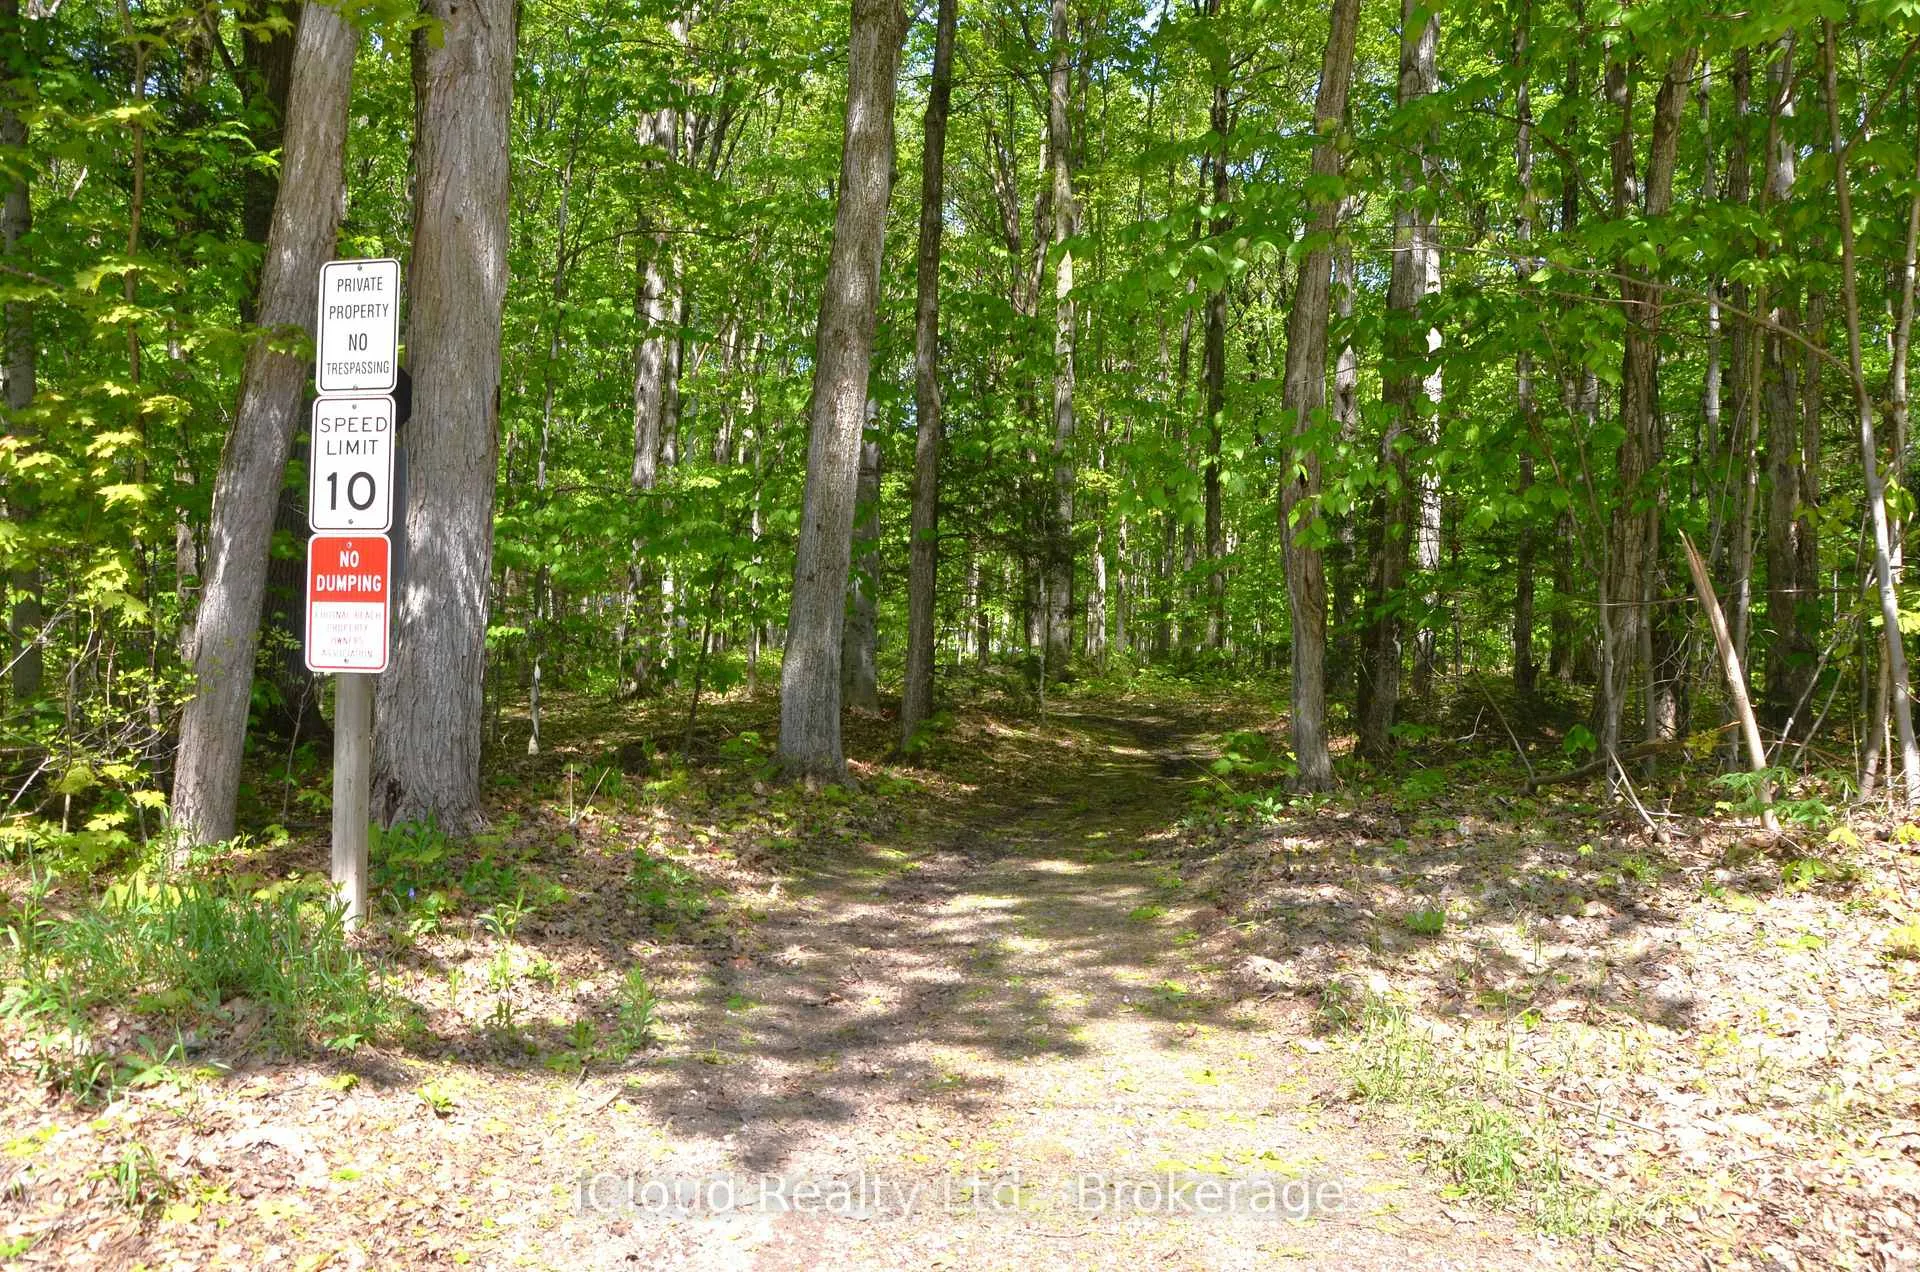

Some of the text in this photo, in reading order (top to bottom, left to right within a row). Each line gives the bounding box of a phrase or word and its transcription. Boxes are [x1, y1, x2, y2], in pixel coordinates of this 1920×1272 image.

[337, 276, 383, 292] PRIVATE
[329, 303, 389, 319] PROPERTY
[348, 333, 368, 351] NO
[327, 361, 390, 375] TRESPASSING
[320, 416, 388, 433] SPEED
[326, 439, 379, 455] LIMIT
[326, 471, 376, 511] 10
[339, 550, 360, 568] NO
[316, 574, 382, 592] DUMPING
